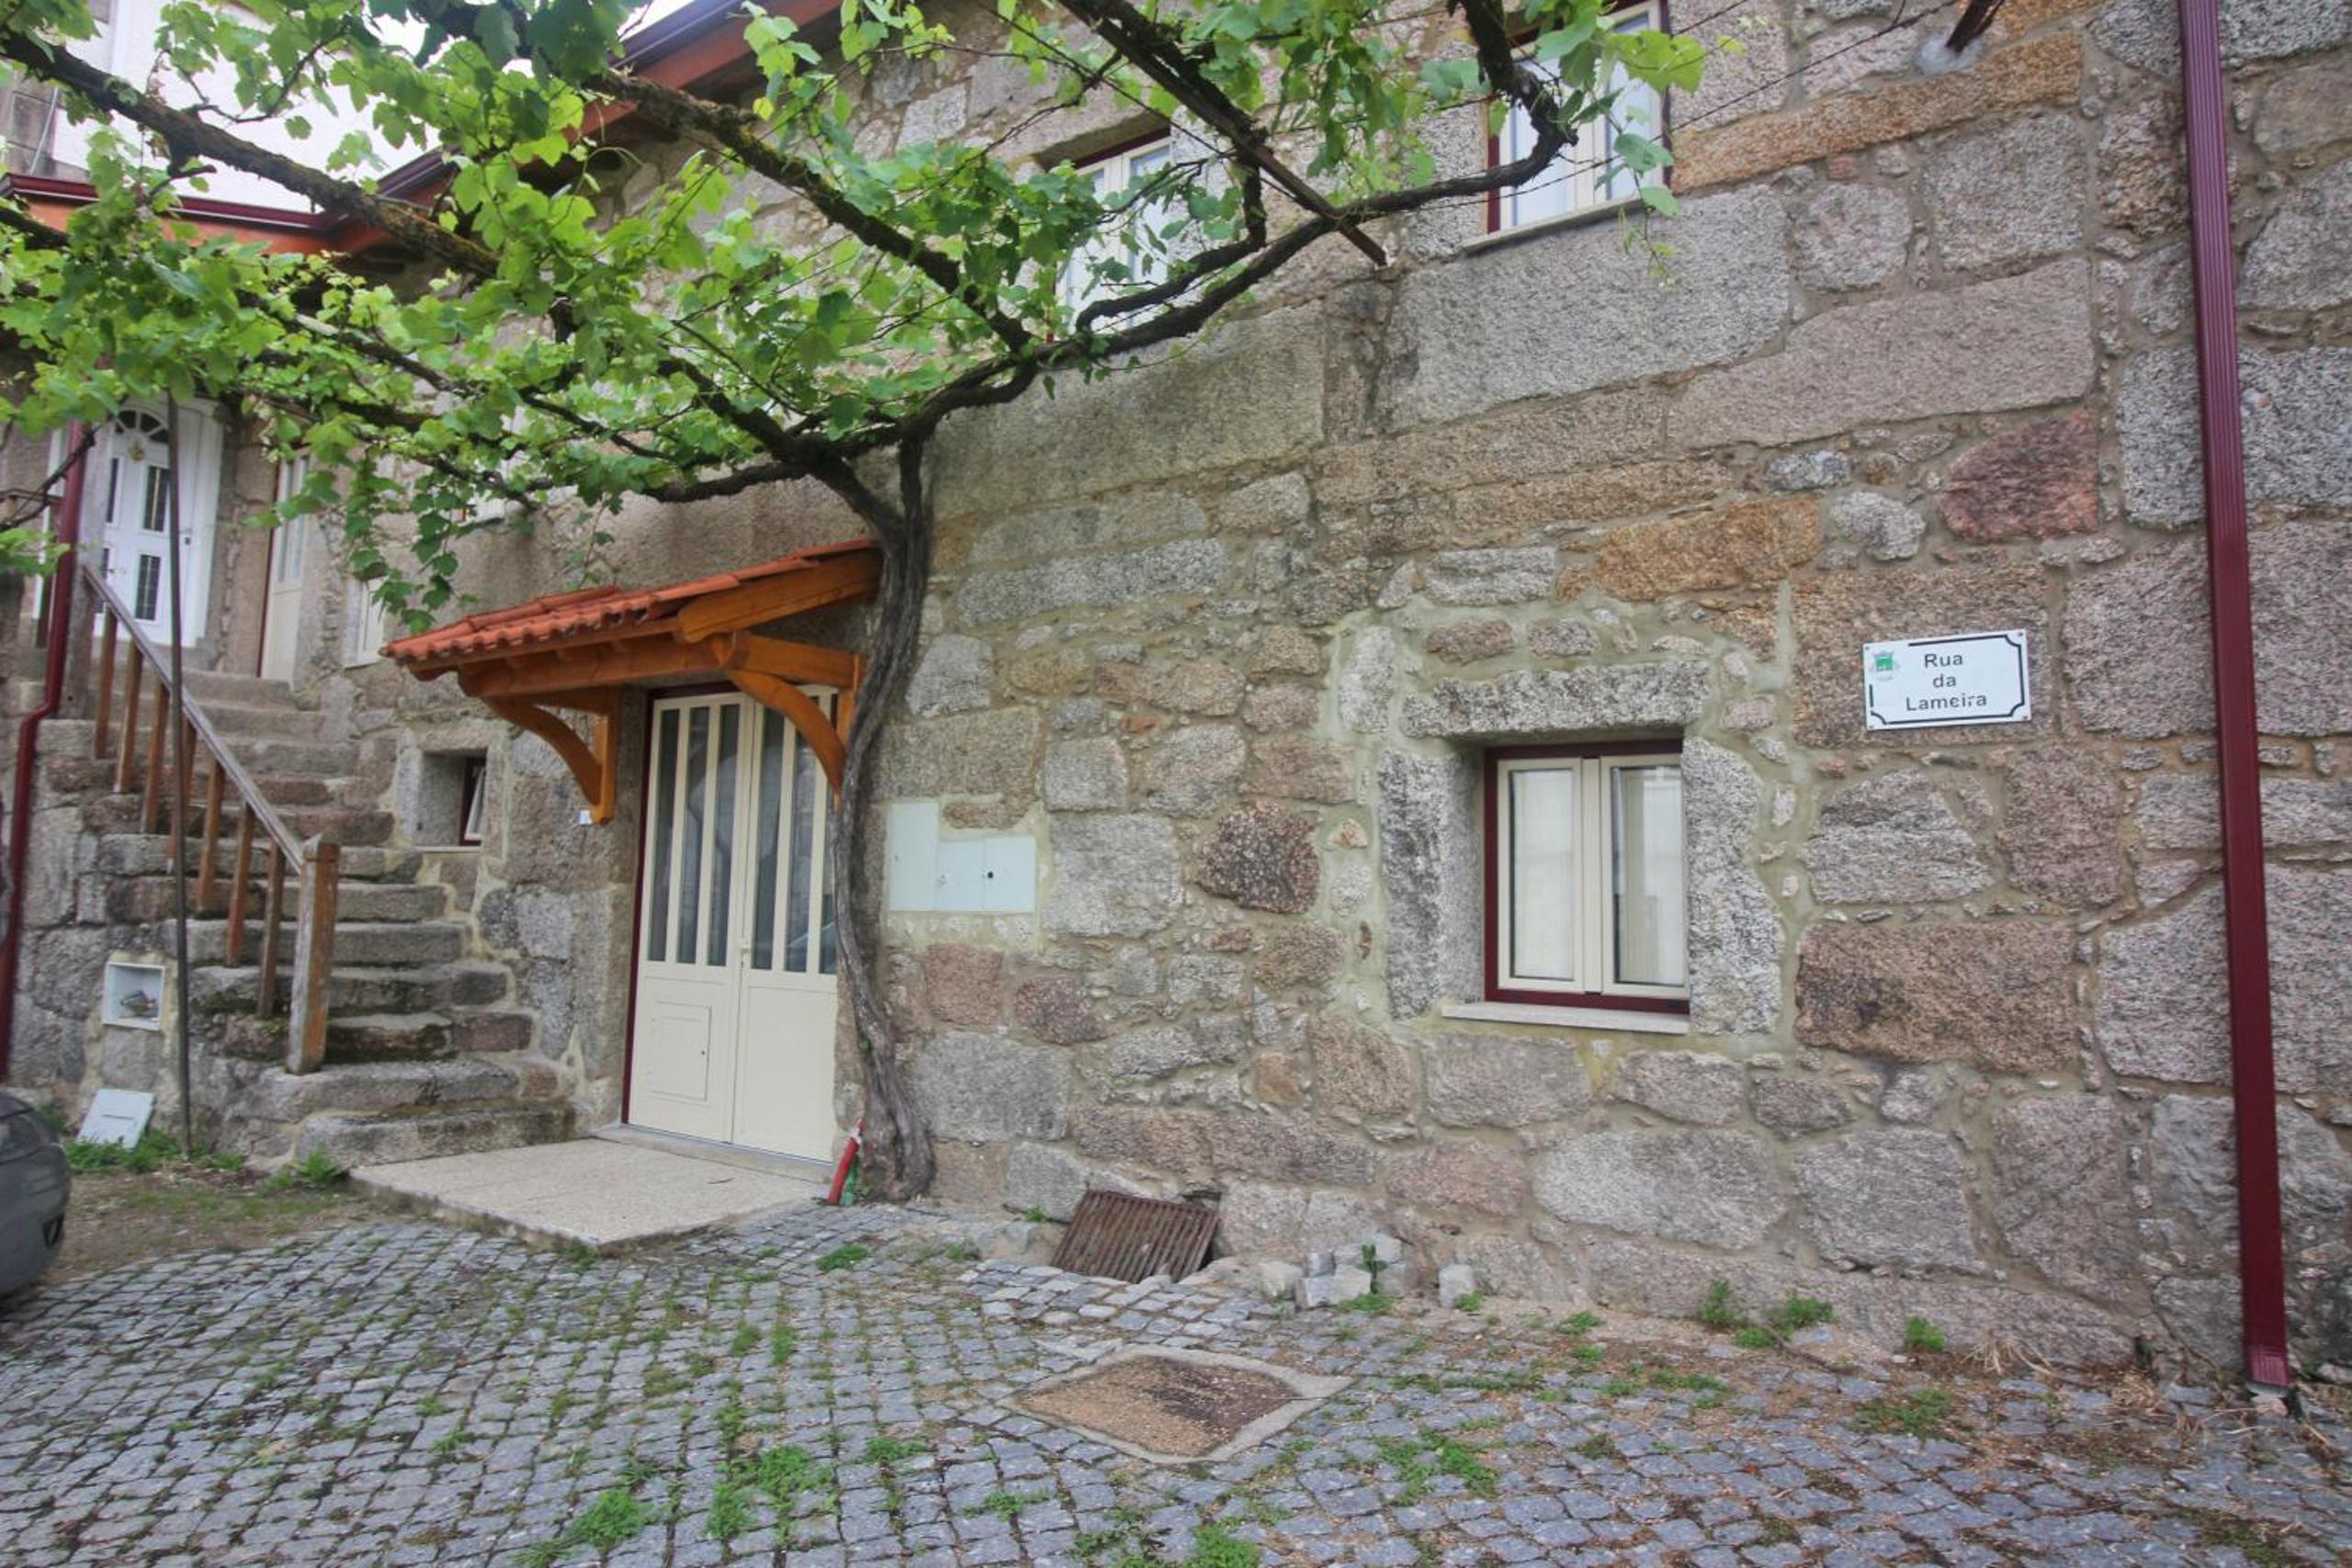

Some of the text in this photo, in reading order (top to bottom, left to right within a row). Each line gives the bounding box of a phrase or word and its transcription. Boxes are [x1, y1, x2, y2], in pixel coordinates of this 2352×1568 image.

[1925, 653, 1963, 668] Rua
[1932, 673, 1957, 689] da
[1905, 693, 1987, 712] Lameira
